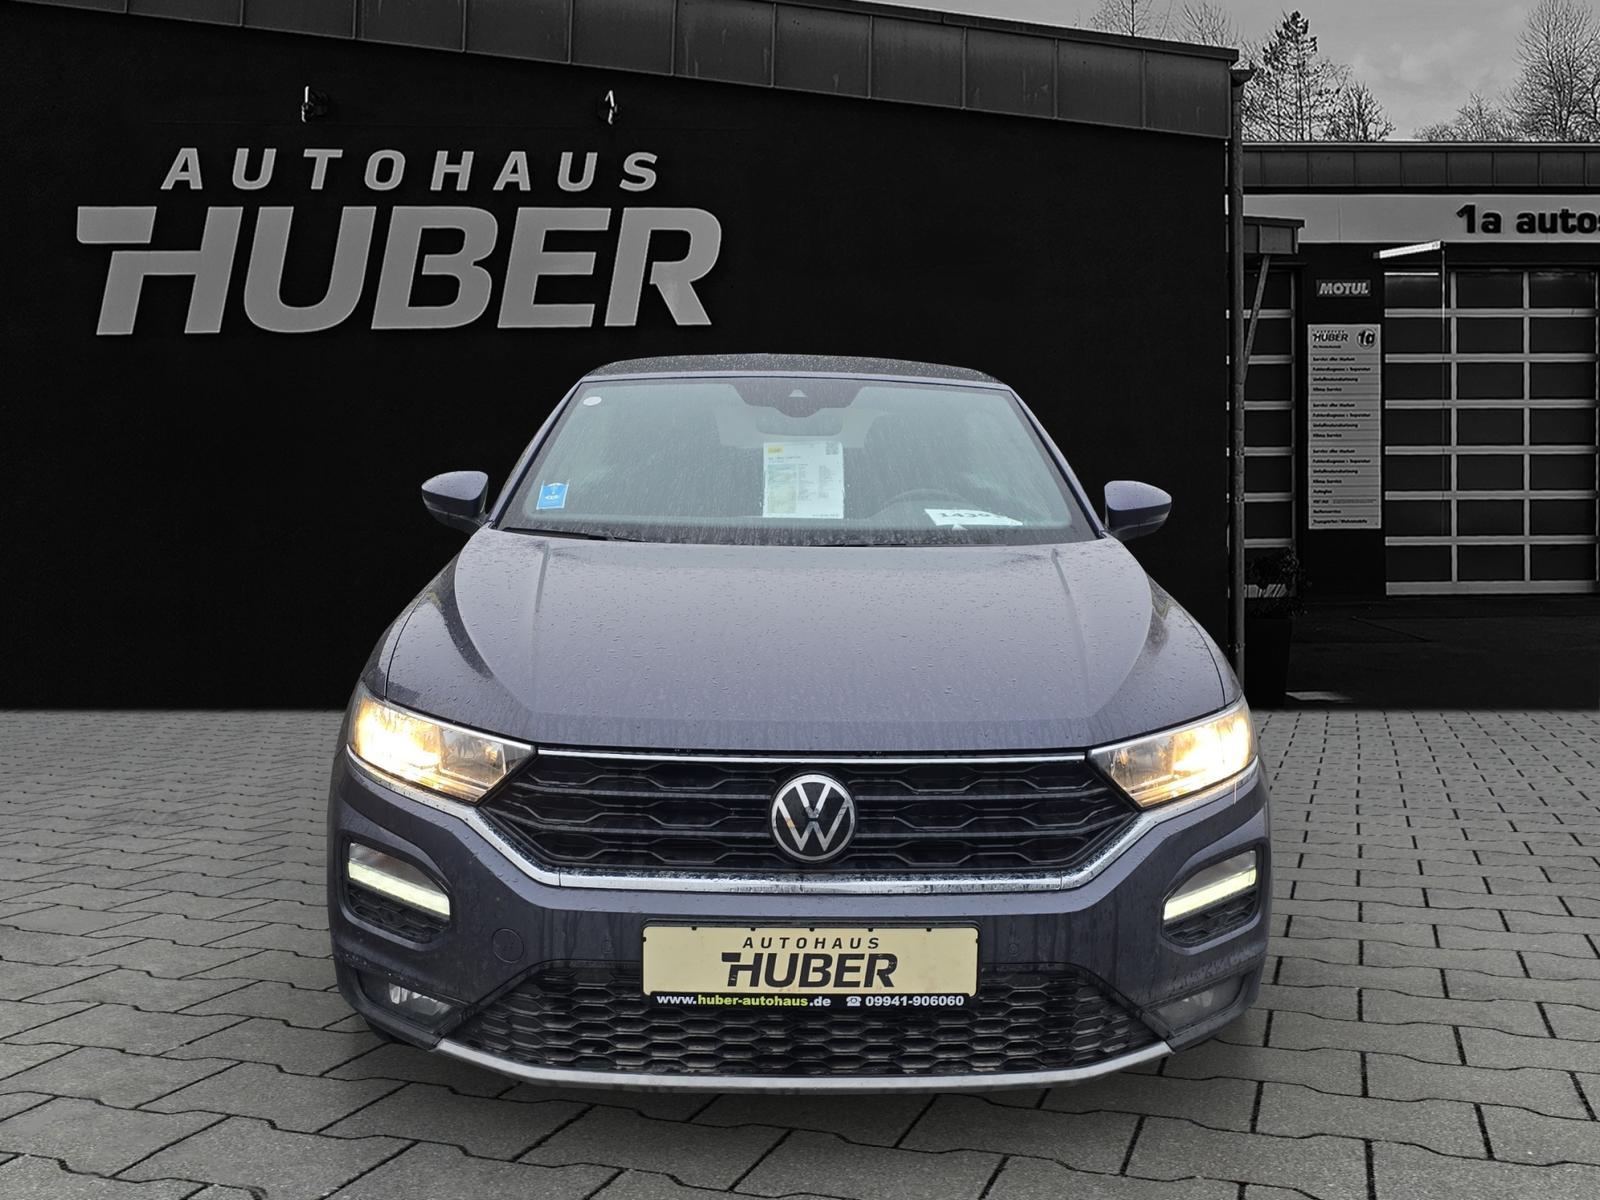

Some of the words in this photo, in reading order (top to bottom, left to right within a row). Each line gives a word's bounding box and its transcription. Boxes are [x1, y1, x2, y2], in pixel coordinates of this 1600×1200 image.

[161, 147, 658, 192] AUTOHAUS
[1456, 204, 1502, 234] 1a
[1516, 208, 1600, 234] auto
[76, 206, 722, 335] HUBER
[1319, 282, 1369, 295] MOTUL
[1312, 333, 1349, 342] HUBER
[742, 937, 880, 949] AUTOHAUS
[721, 952, 898, 988] HUBER
[656, 994, 832, 1007] www.huber-autohaus.de
[865, 996, 965, 1007] 09941-906060
